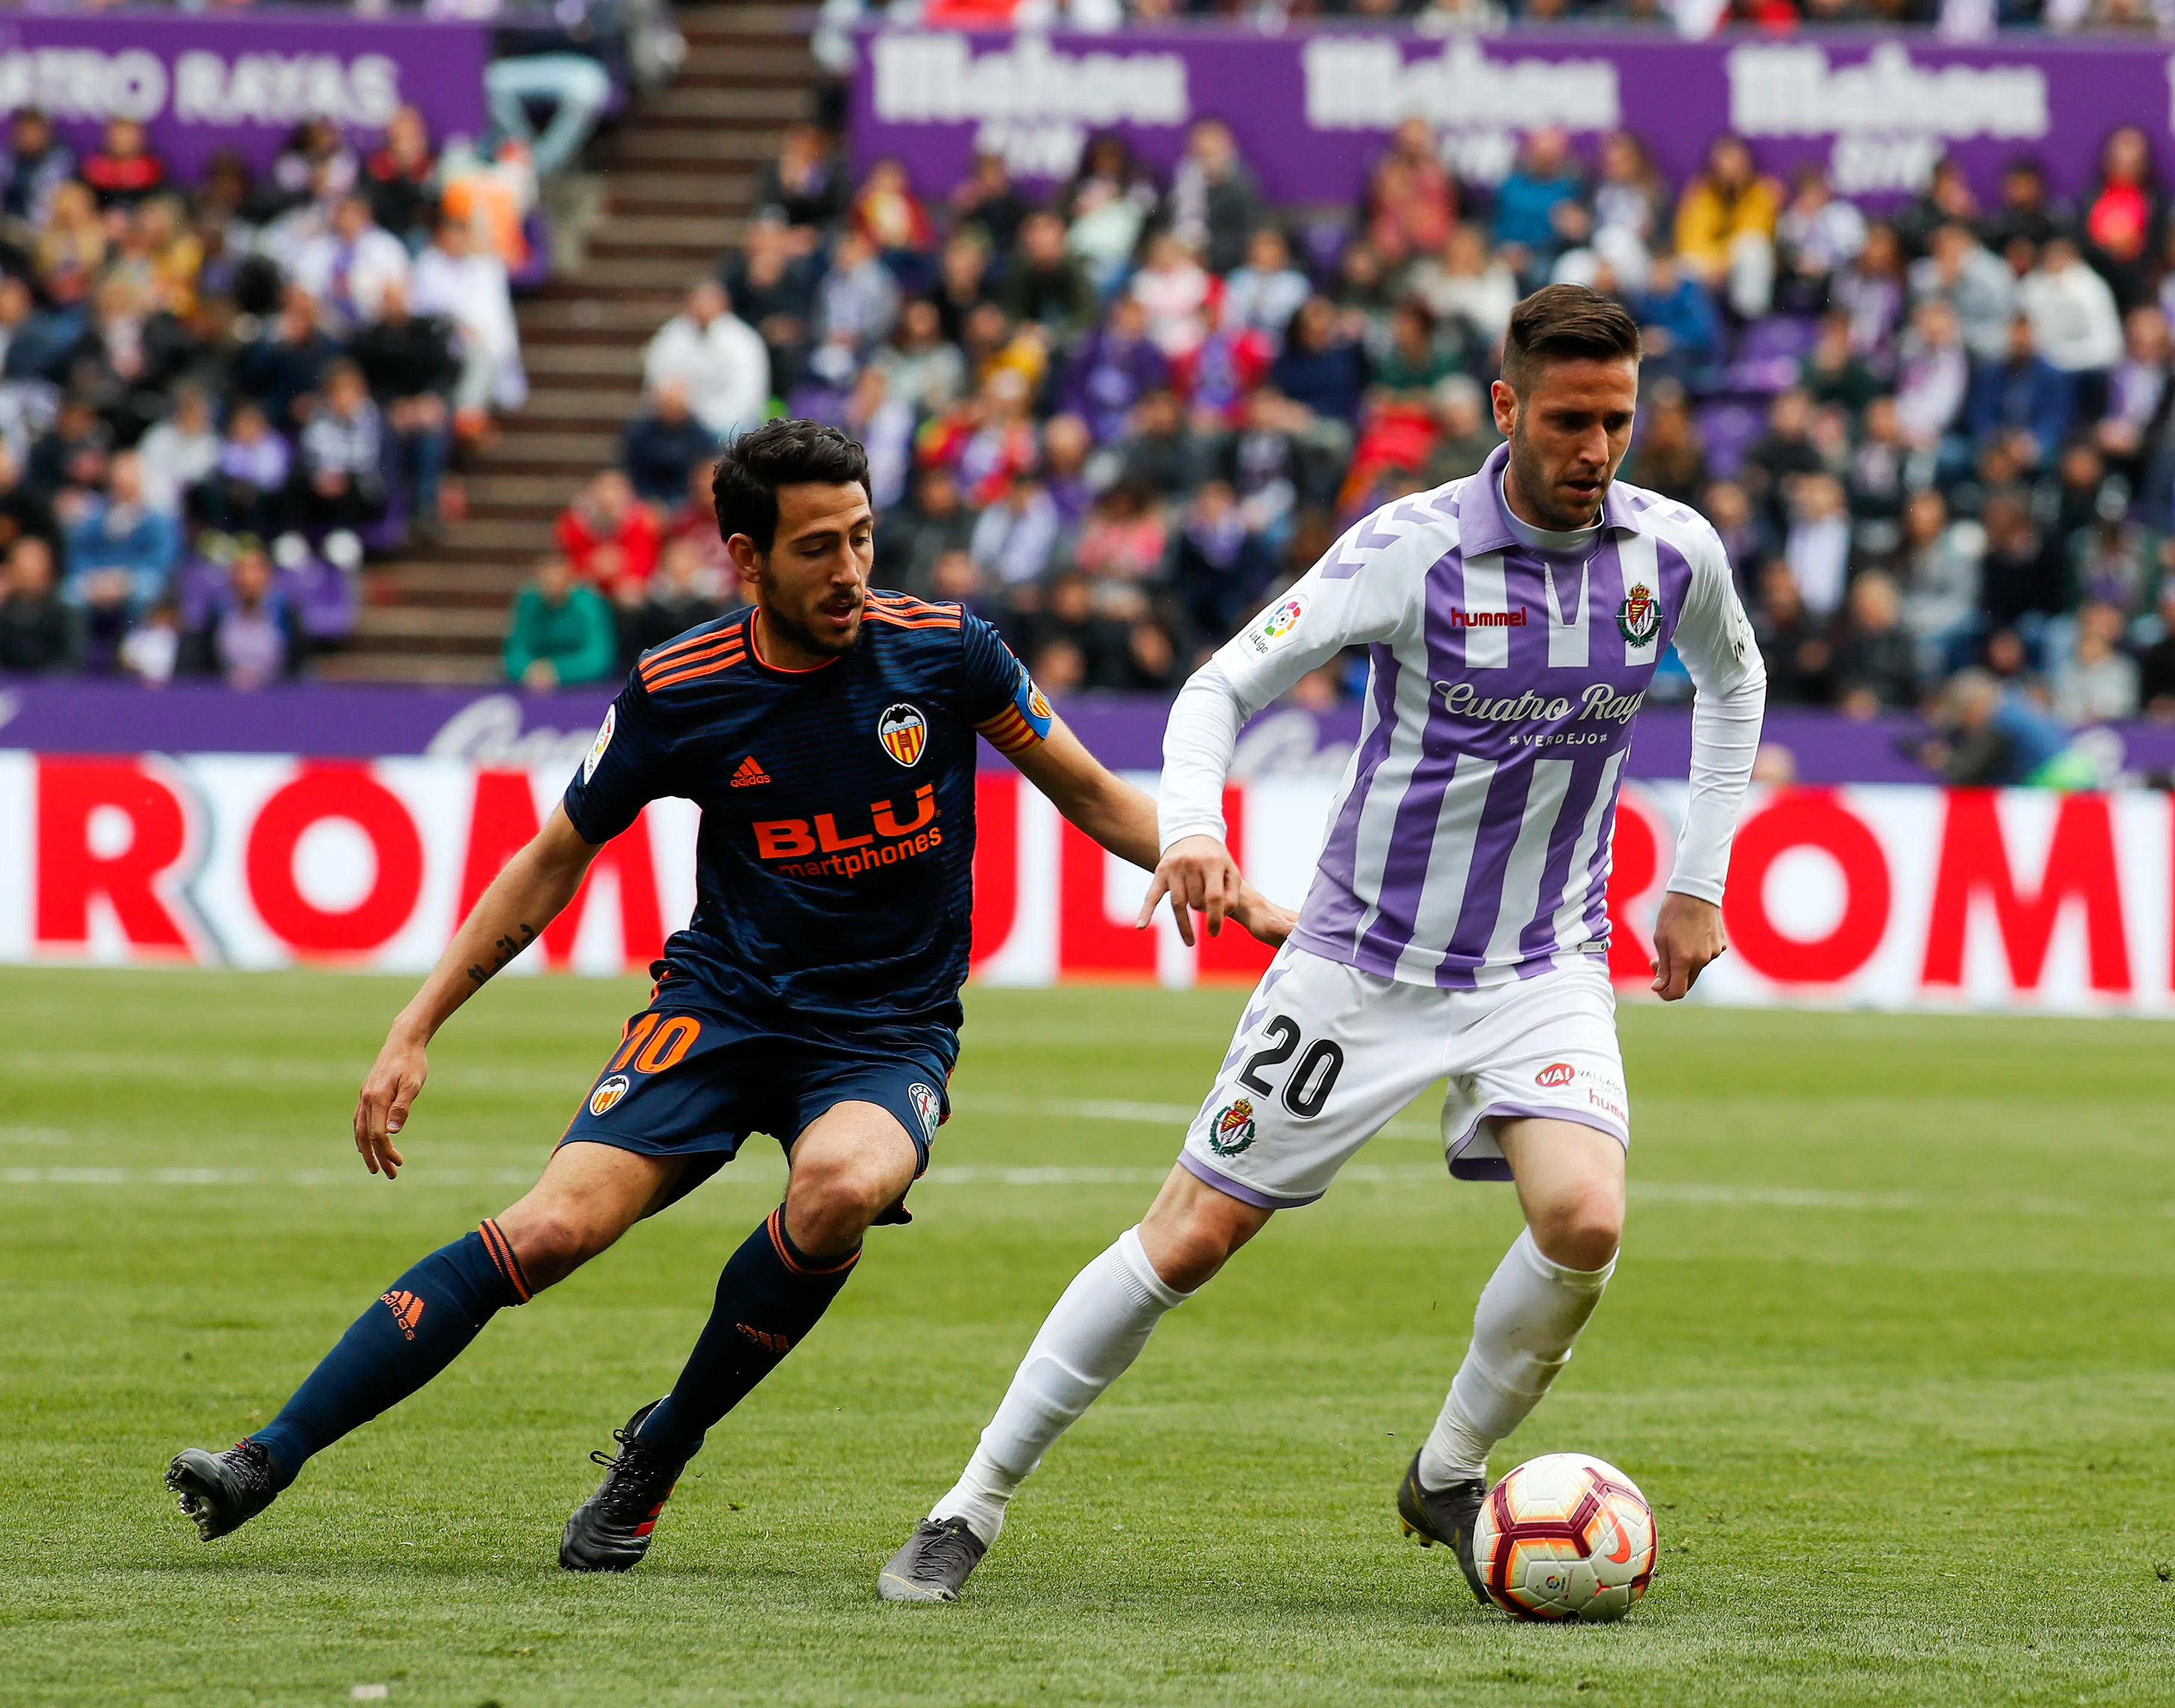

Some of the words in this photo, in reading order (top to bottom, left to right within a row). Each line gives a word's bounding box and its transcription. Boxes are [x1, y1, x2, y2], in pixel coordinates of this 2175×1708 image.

[1451, 606, 1527, 627] hummel
[1434, 680, 1575, 722] Cuatro
[1577, 683, 1647, 725] Ray
[730, 773, 771, 788] adidas
[752, 783, 935, 859] BLU
[609, 1013, 702, 1074] 10
[1234, 1014, 1344, 1119] 20
[380, 1293, 415, 1341] adidas
